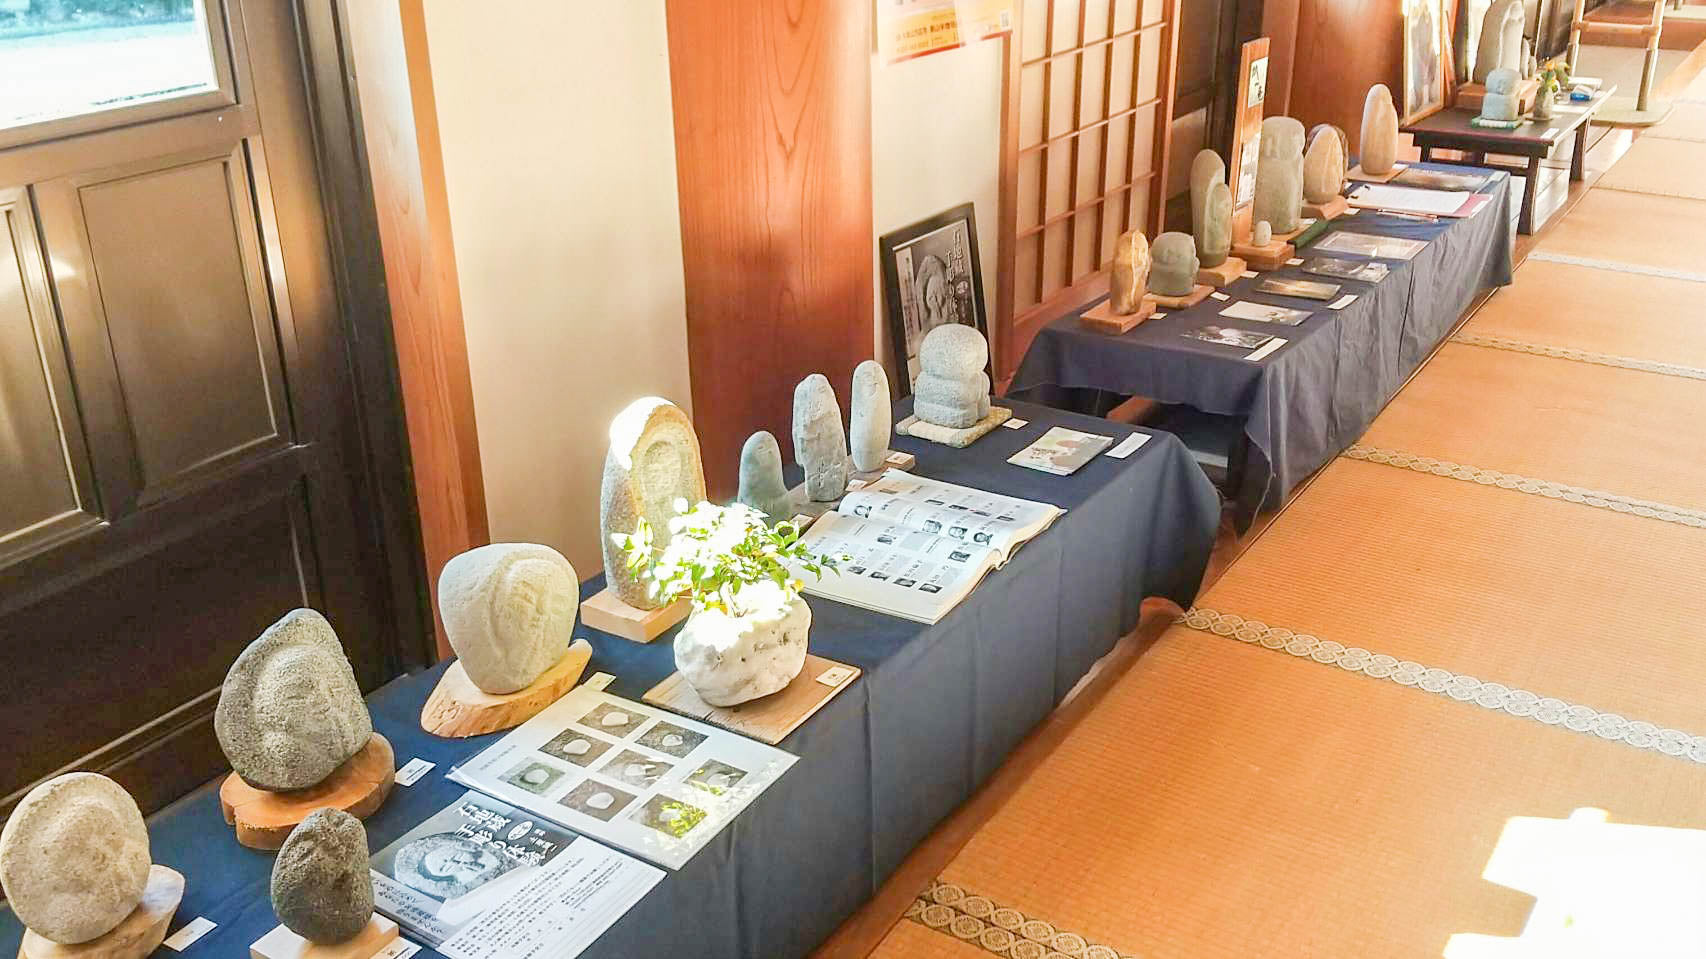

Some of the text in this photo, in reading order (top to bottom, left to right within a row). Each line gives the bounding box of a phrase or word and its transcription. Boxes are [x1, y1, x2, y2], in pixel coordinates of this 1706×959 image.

[453, 802, 512, 832] 石地蔵
[454, 823, 548, 867] 手彫り体験
